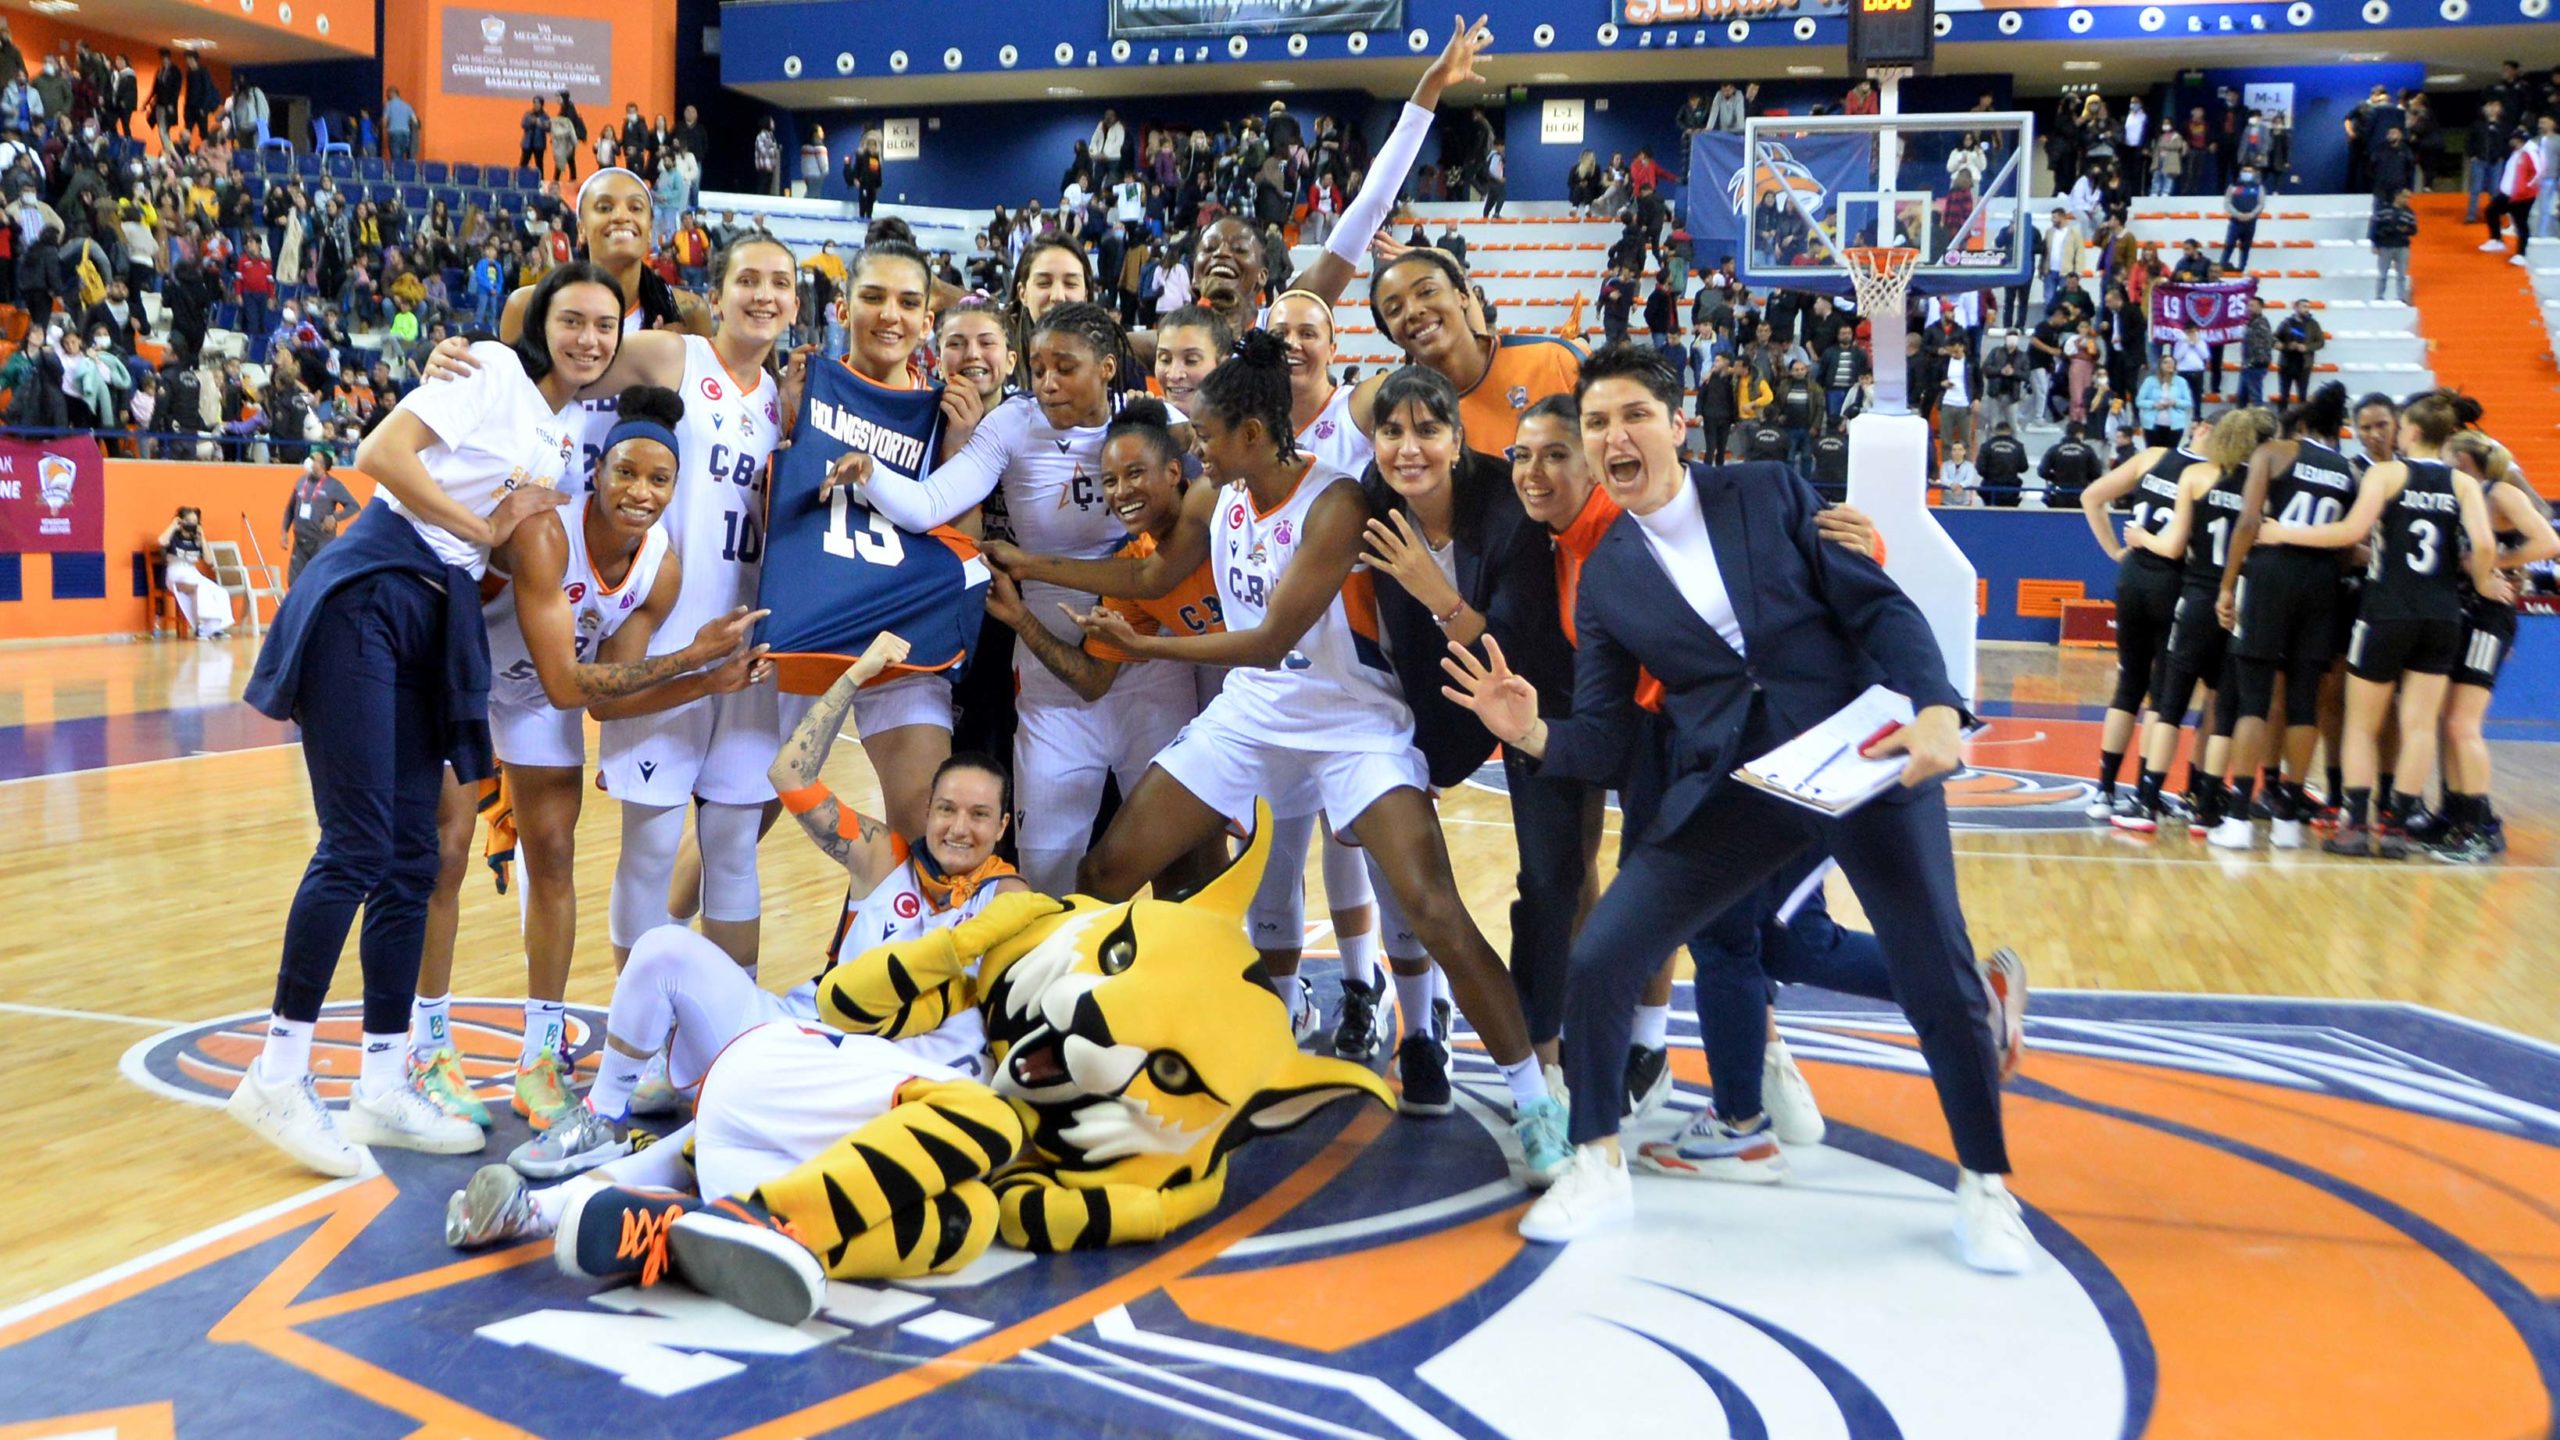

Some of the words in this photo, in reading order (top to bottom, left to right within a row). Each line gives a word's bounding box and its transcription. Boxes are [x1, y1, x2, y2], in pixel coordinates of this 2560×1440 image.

[452, 63, 501, 77] ÇUKUROVA
[502, 67, 551, 79] BASKETBOL
[886, 139, 916, 150] BLOK
[2163, 295, 2180, 319] 19
[2227, 293, 2246, 318] 25
[2278, 490, 2342, 530] 40
[722, 510, 761, 564] 10
[2406, 518, 2438, 575] 3
